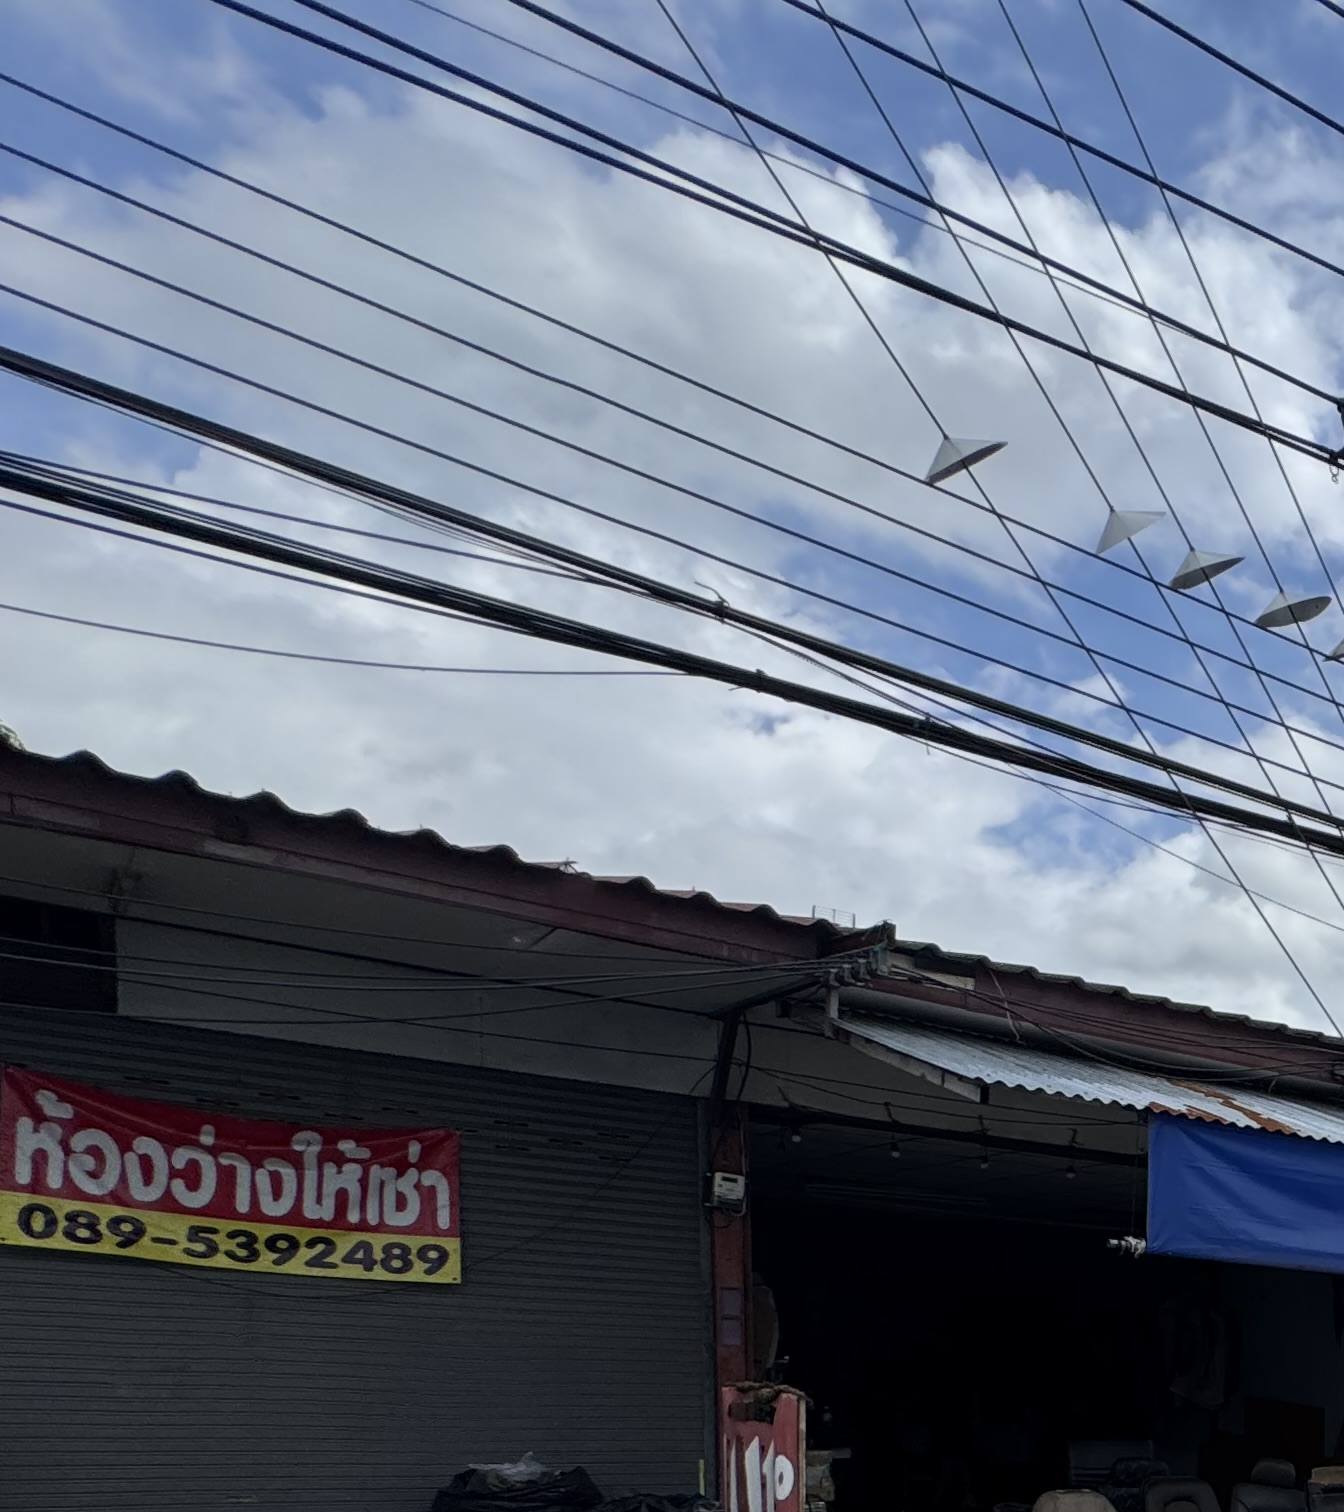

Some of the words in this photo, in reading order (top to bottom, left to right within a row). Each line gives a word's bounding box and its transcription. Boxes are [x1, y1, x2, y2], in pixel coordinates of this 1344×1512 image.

[14, 1089, 451, 1230] ห้องว่างให้เช่า
[17, 1203, 450, 1276] 089-5392489
